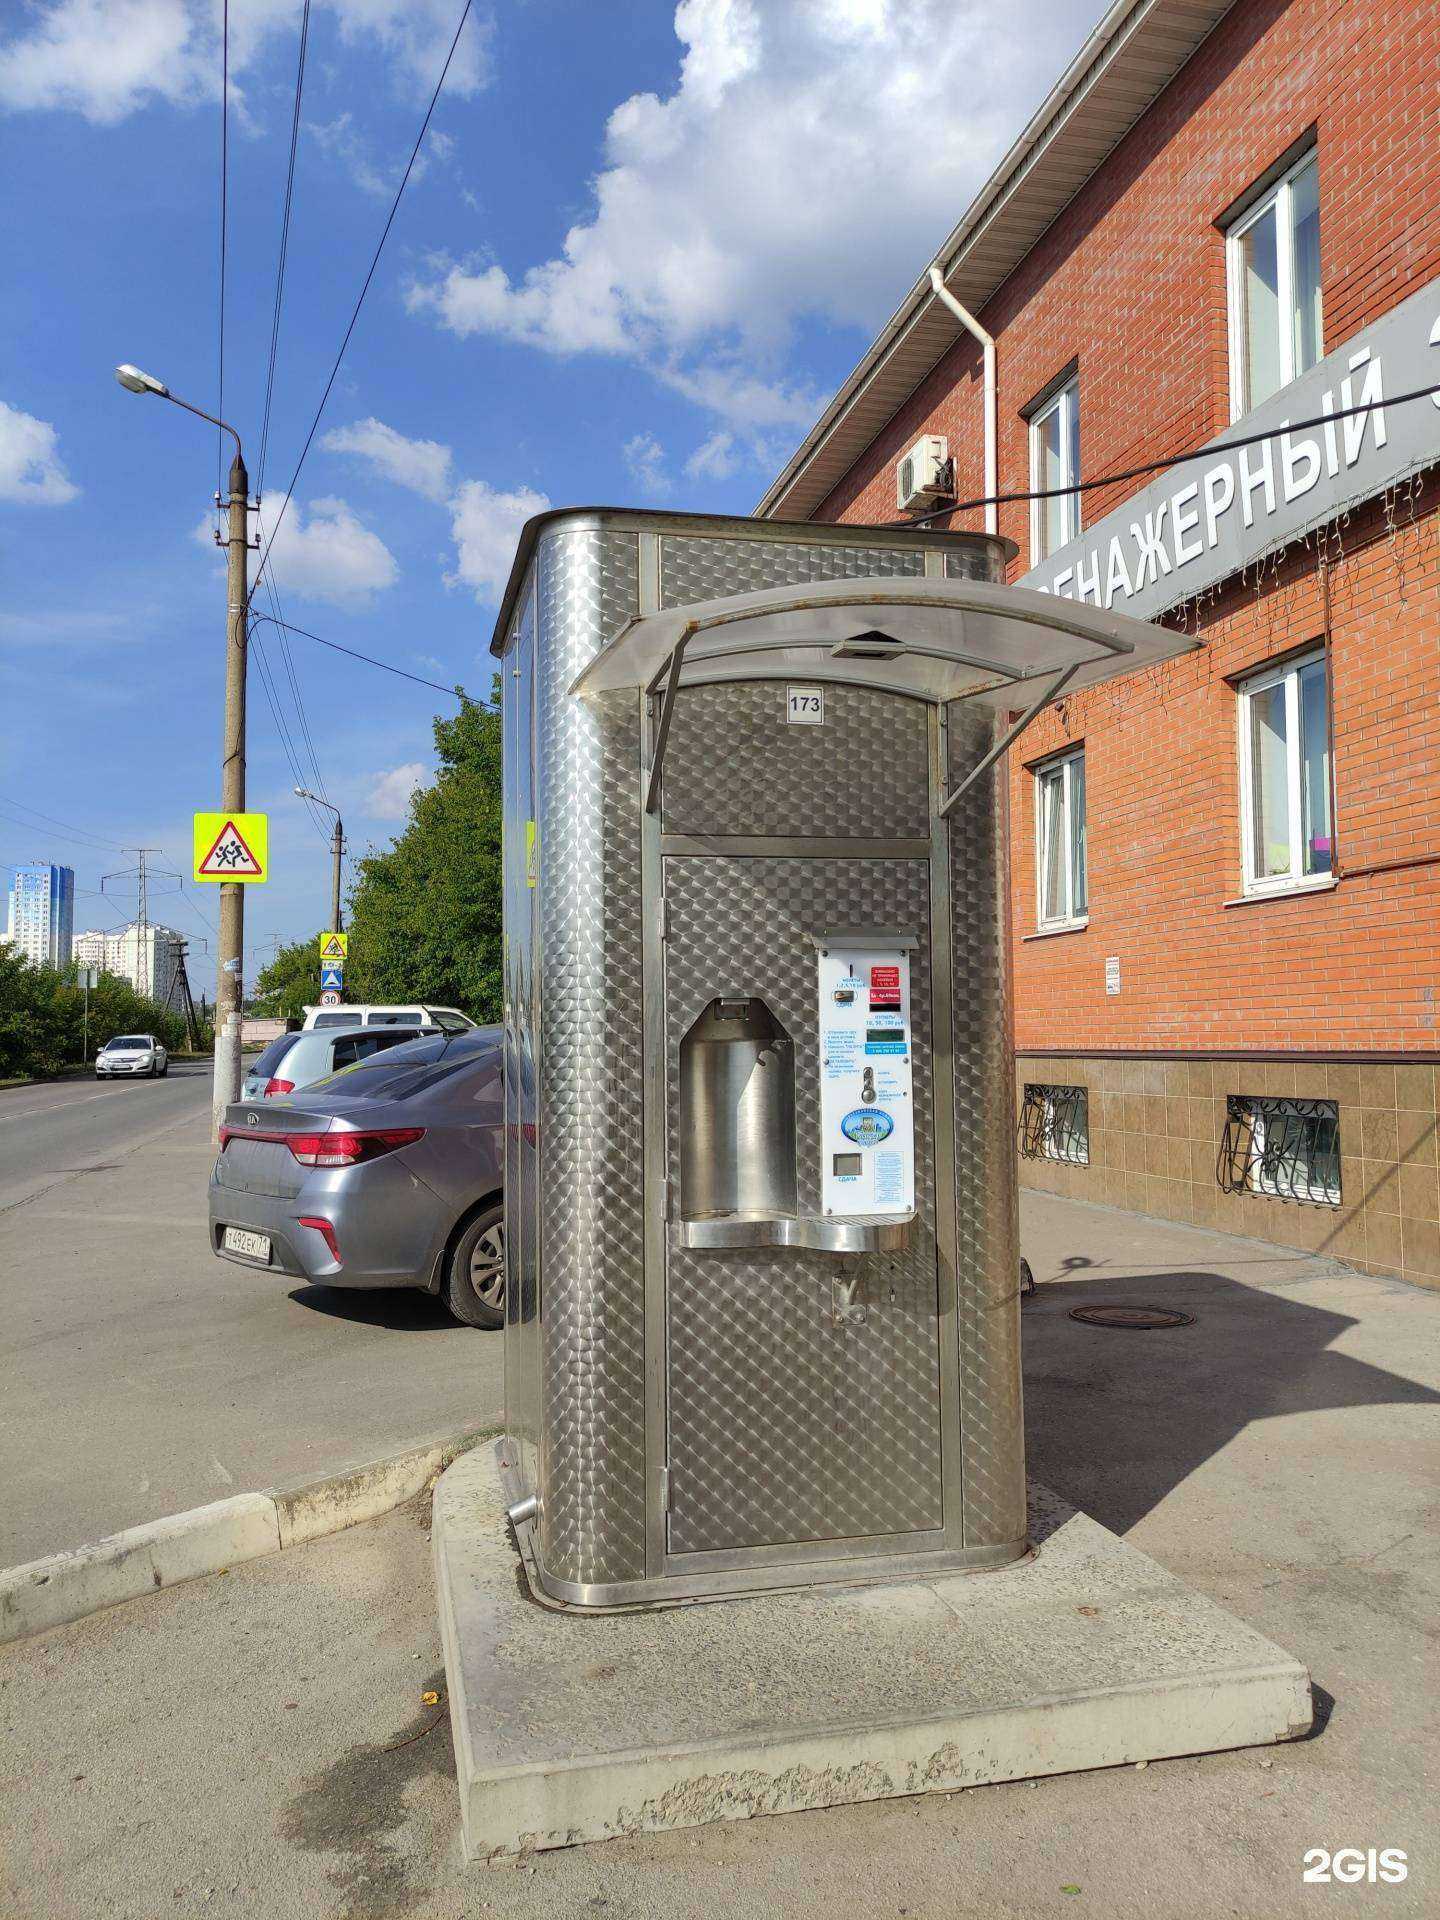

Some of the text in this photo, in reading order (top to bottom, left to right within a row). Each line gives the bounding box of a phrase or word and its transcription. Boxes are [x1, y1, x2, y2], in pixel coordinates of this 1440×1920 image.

[1036, 345, 1388, 610] ЕНАЖЕРНЫЙ
[790, 696, 820, 712] 173
[324, 996, 336, 1004] 30
